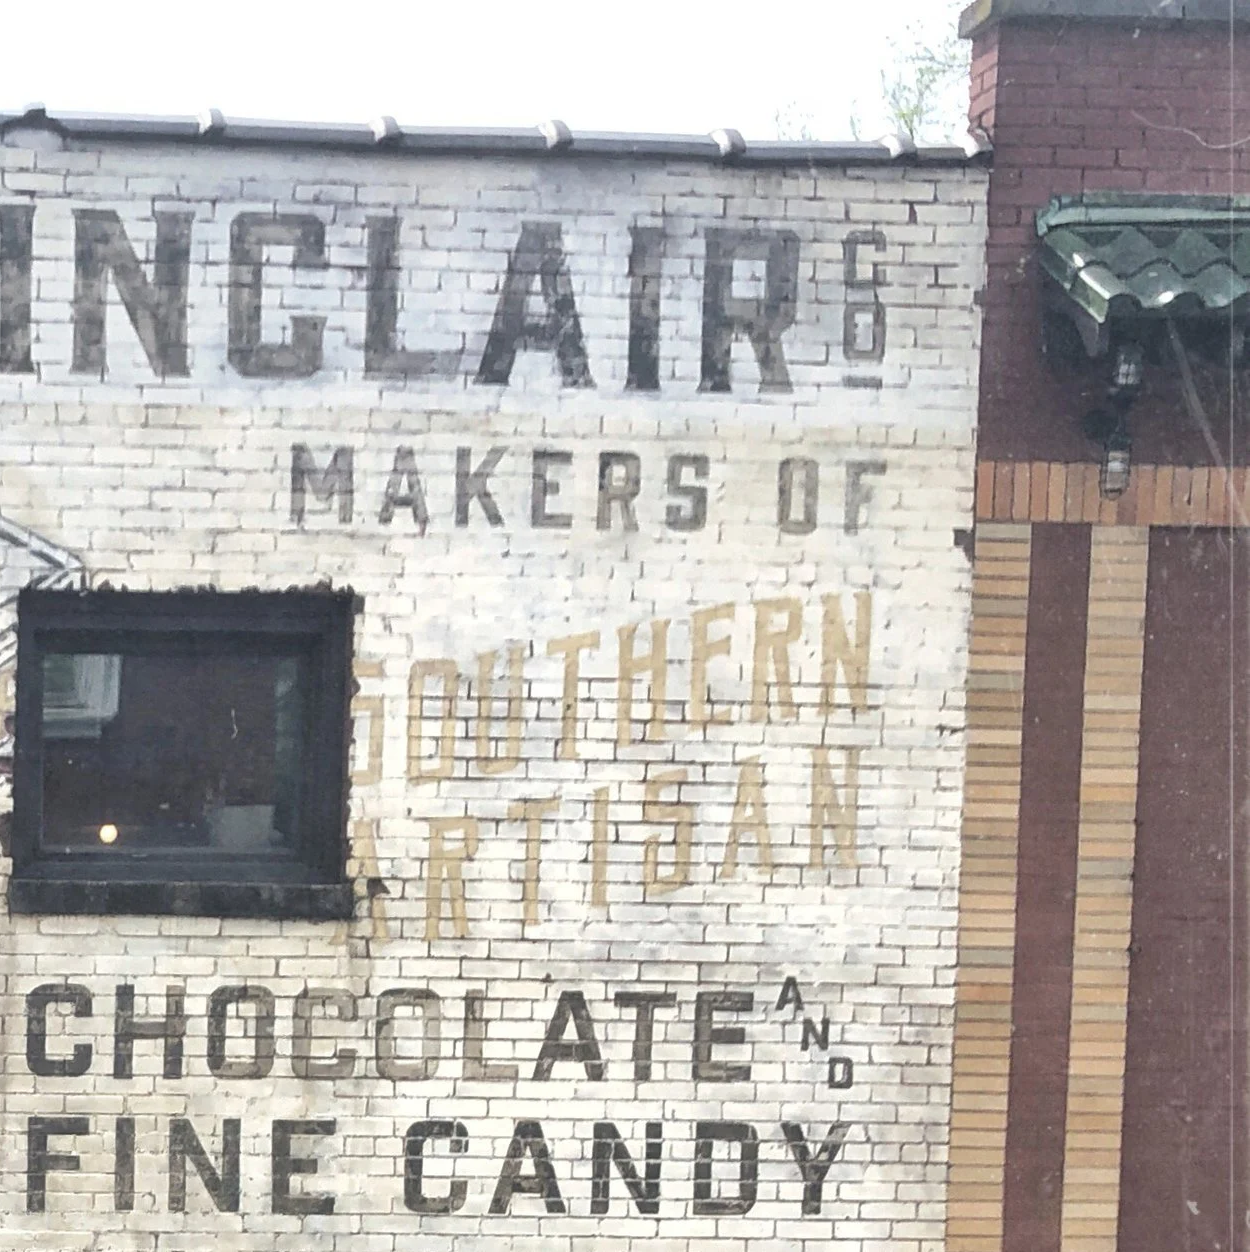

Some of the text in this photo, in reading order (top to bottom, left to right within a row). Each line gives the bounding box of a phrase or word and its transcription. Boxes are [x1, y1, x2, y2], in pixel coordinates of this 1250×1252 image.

[291, 444, 887, 536] MAKERS OF
[350, 592, 873, 787] SOUTHERN
[329, 747, 862, 945] ARTISAN
[26, 976, 854, 1089] CHOCOLATE AND
[26, 1117, 850, 1215] FINE CANDY
